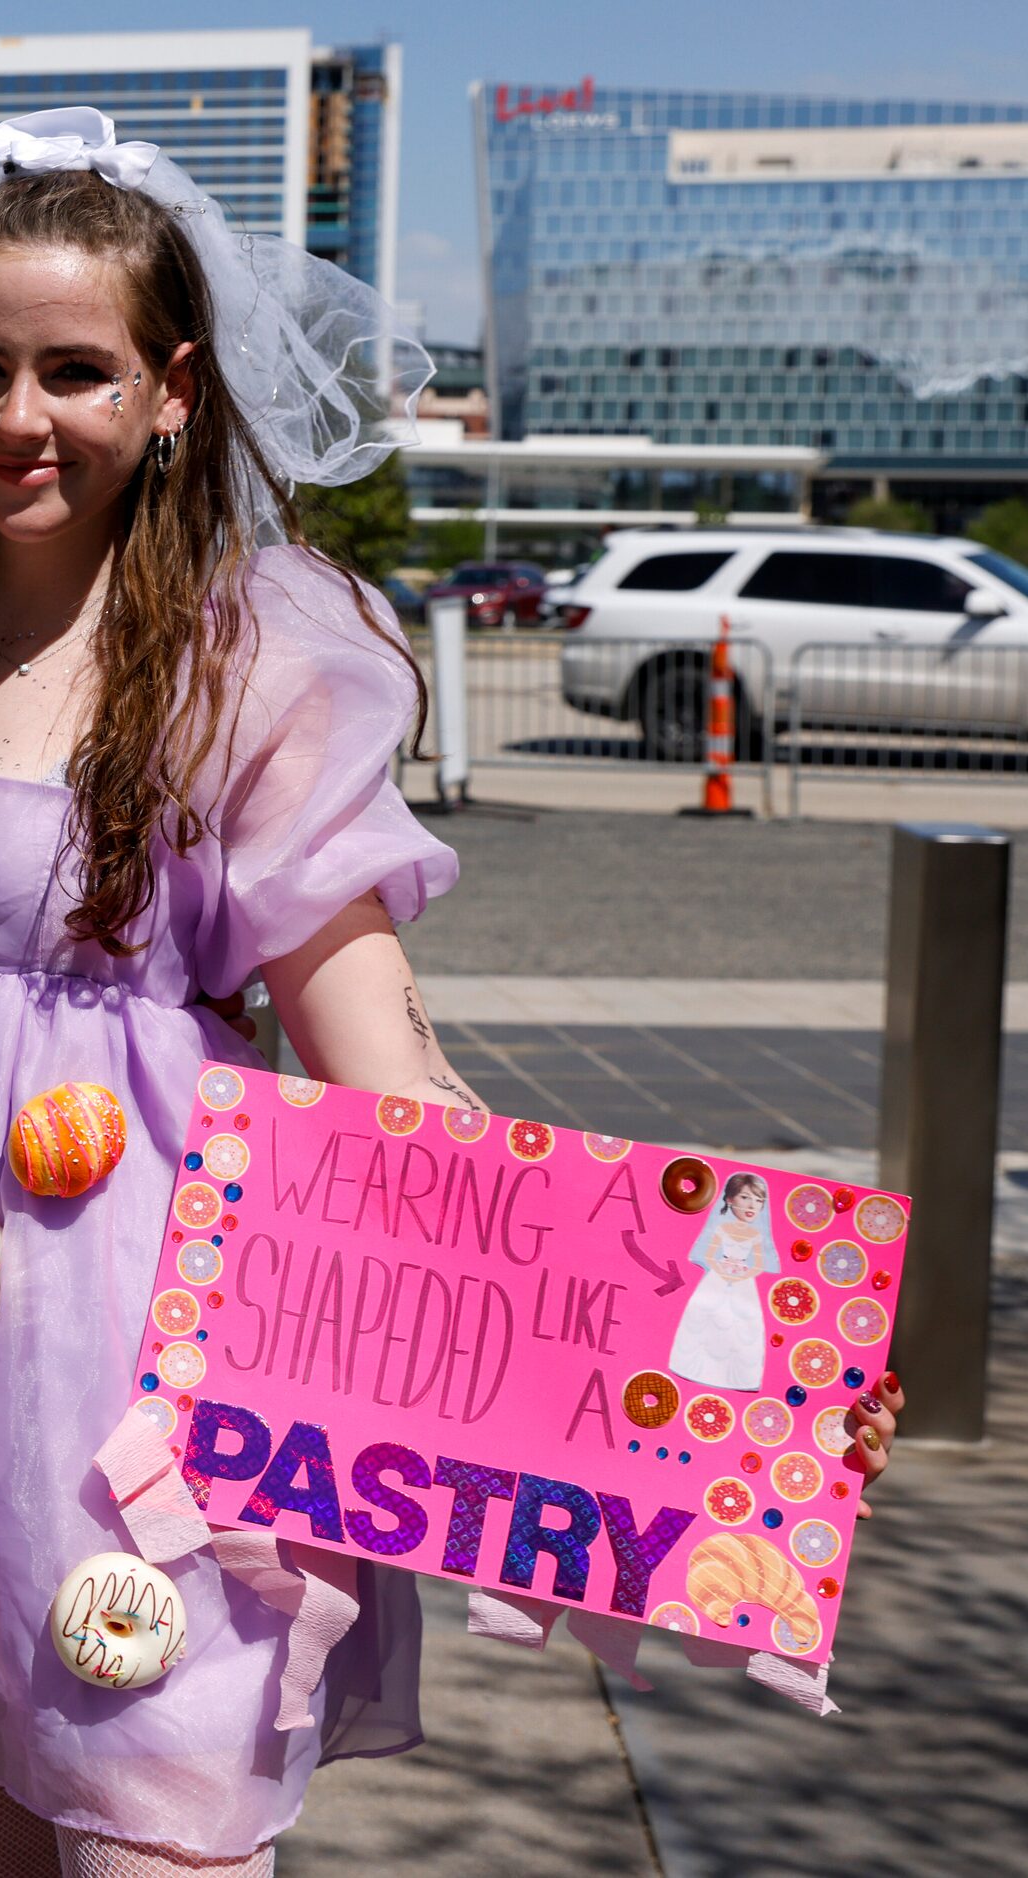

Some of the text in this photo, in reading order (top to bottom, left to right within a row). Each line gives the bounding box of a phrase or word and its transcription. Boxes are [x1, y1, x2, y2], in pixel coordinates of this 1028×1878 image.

[271, 1116, 647, 1267] WEARING A
[224, 1232, 628, 1425] SHAPEDED LIKE
[565, 1367, 616, 1450] A
[182, 1397, 698, 1618] PASTRY
